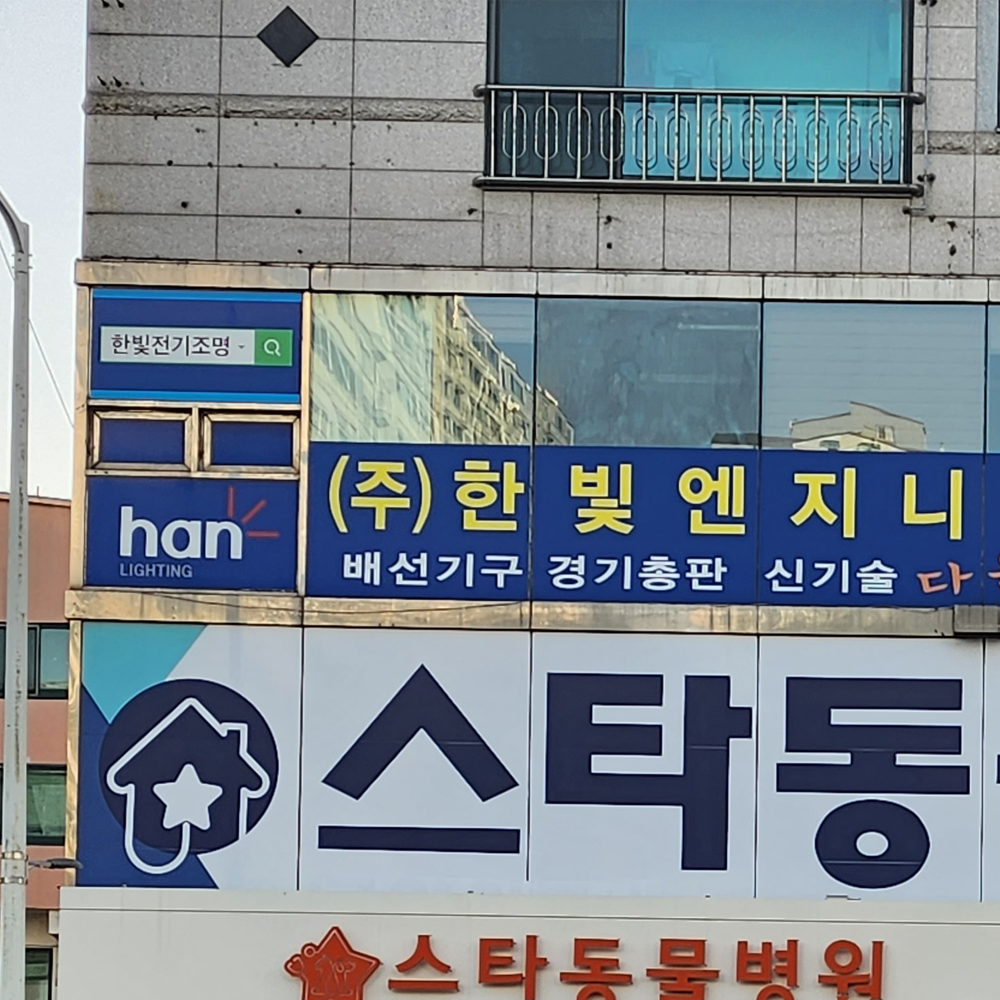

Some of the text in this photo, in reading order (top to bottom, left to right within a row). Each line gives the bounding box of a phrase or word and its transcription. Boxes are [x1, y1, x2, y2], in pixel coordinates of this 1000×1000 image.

[111, 333, 231, 357] 한빛전기조명
[119, 506, 243, 560] han
[119, 563, 193, 579] LIGHTING
[342, 551, 523, 589] 배선기구
[547, 554, 728, 592] 경기총판
[763, 557, 899, 595] 신기술
